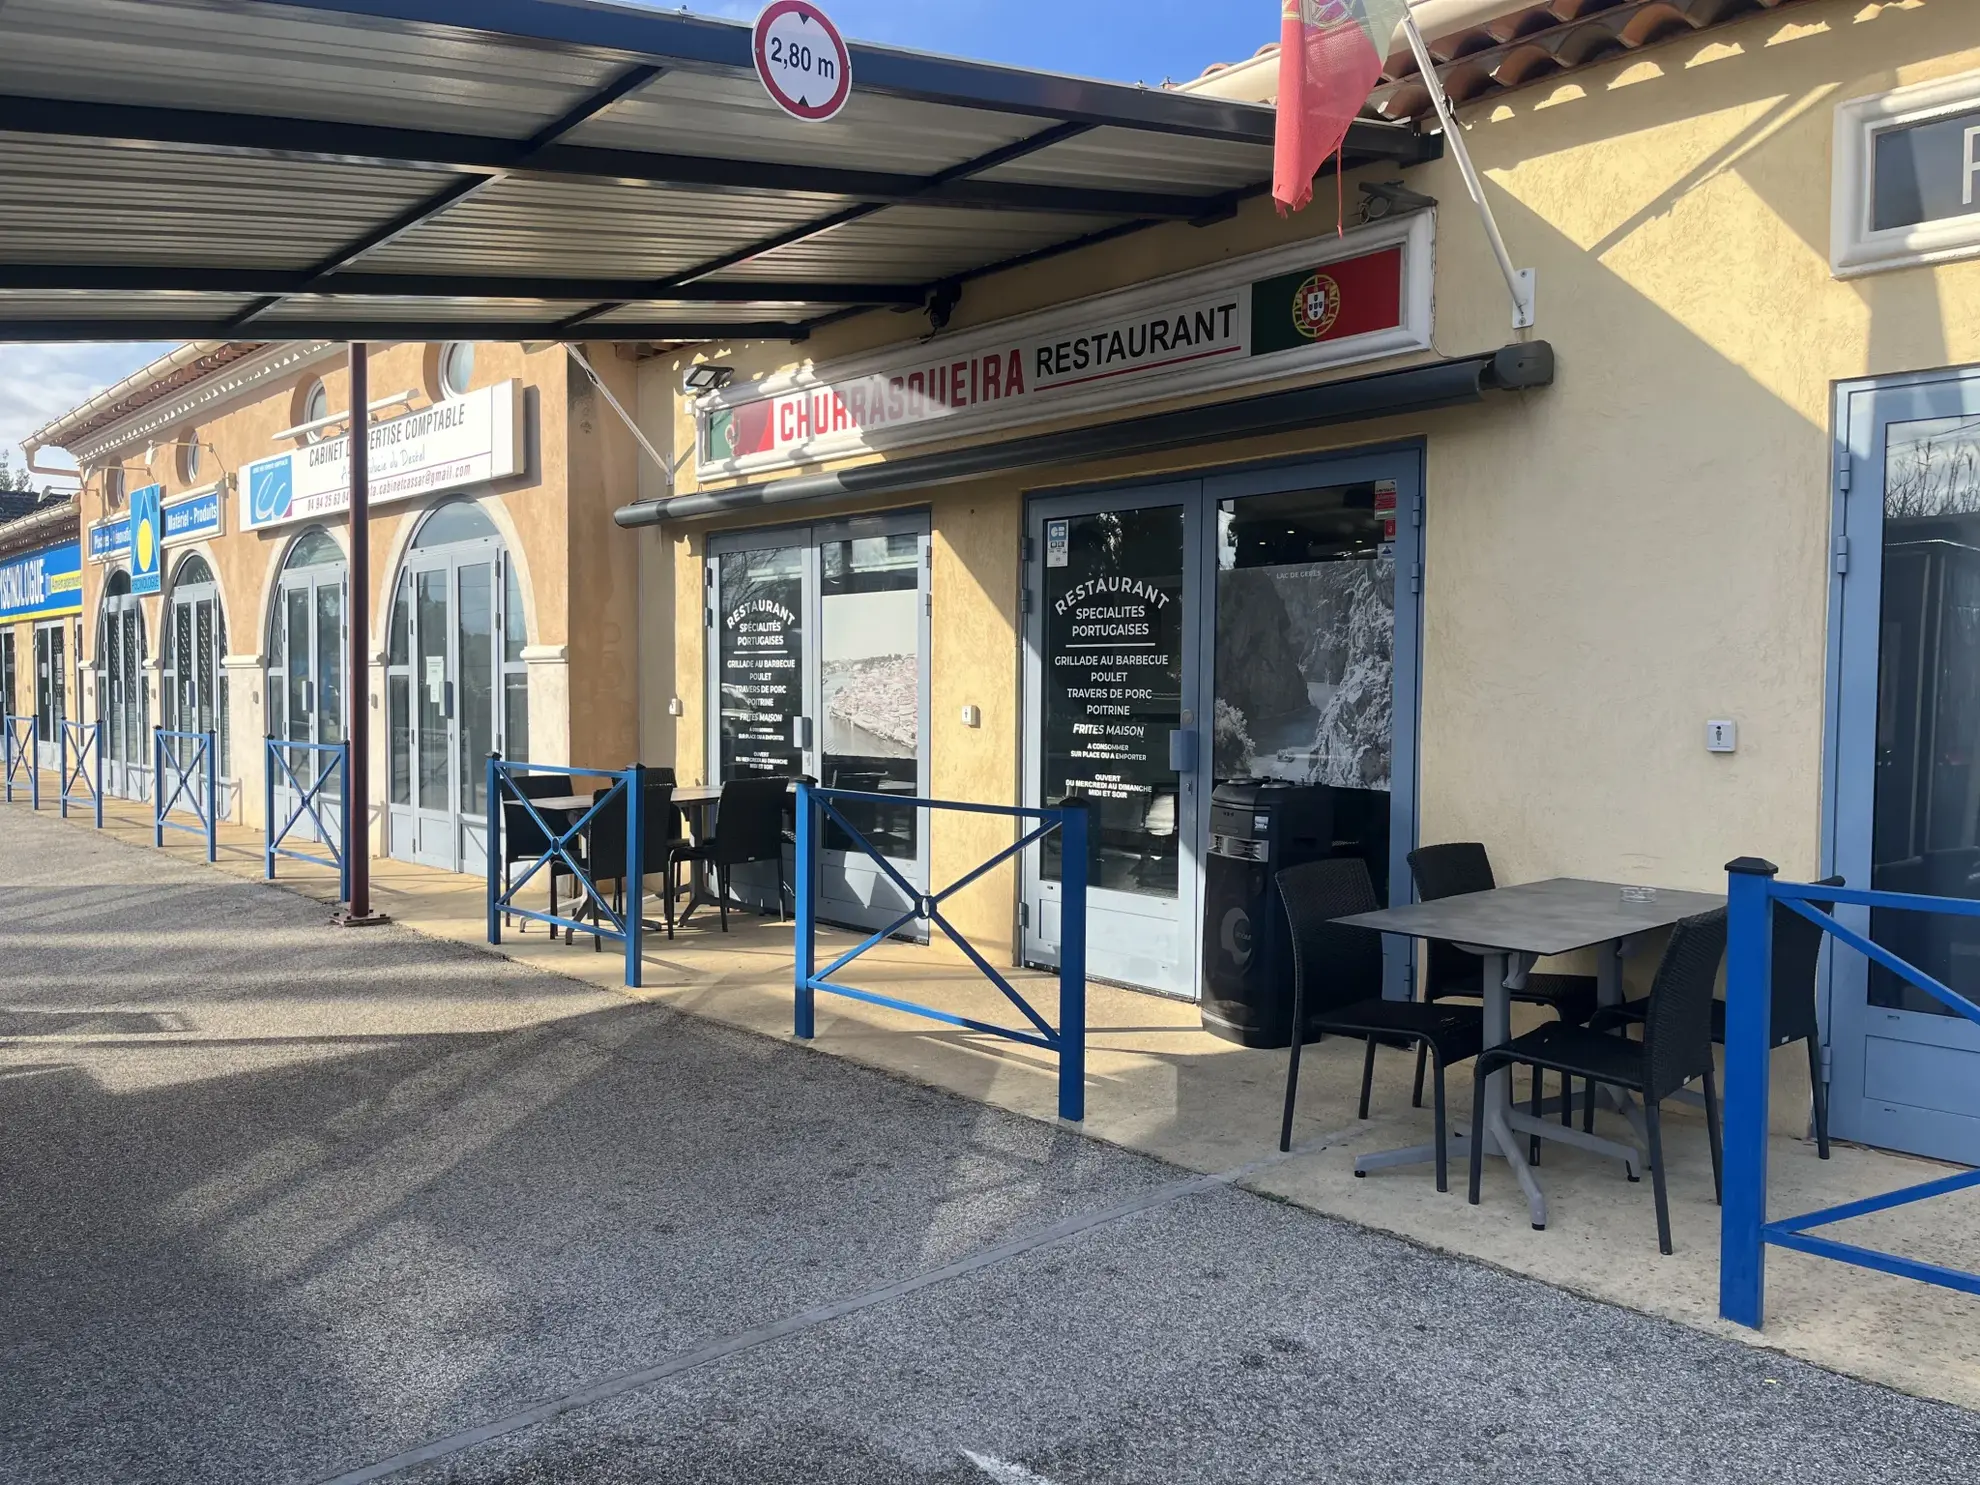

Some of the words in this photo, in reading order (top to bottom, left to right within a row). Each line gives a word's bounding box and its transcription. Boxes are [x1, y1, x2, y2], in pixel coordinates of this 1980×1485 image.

[771, 37, 811, 72] 2,80
[817, 57, 834, 80] m
[780, 348, 1025, 443] CHURRASQUEIRA
[1036, 302, 1237, 378] RESTAURANT
[309, 440, 344, 468] CABINET
[405, 403, 466, 441] COMPTABLE
[193, 502, 218, 524] Produits
[1054, 576, 1170, 616] RESTAURANT
[726, 599, 796, 630] RESTAURANT
[1076, 605, 1146, 620] SPECIALITES
[1072, 623, 1149, 637] PORTUGAISES
[737, 635, 784, 646] PORTUGAISES
[727, 659, 754, 669] GRILLADE
[755, 659, 764, 668] AU
[764, 659, 796, 668] BARBECUE
[1054, 655, 1099, 666] GRILLADE
[1100, 655, 1113, 666] AU
[1116, 654, 1169, 665] BARBECUE
[750, 672, 772, 681] POULET
[1090, 672, 1128, 682] POULET
[735, 685, 760, 694] TRAVERS
[761, 685, 770, 693] DE
[770, 685, 787, 694] PORC
[1067, 688, 1107, 699] TRAVERS
[1110, 688, 1123, 699] DE
[1125, 689, 1152, 699] PORC
[748, 698, 774, 707] POITRINE
[1086, 704, 1130, 716] POITRINE
[740, 712, 759, 722] FRITES
[759, 713, 783, 722] MAISON
[1073, 723, 1104, 735] FRITES
[1106, 725, 1145, 736] MAISON
[1092, 743, 1129, 751] CONSOMMER
[1070, 750, 1082, 758] SUR
[1083, 750, 1100, 759] PLACE
[1115, 753, 1147, 761] EMPORTER
[1095, 774, 1121, 782] OUVERT
[1065, 779, 1074, 787] DU
[1075, 780, 1107, 789] MERCREDI
[1108, 782, 1118, 790] AU
[1118, 783, 1153, 793] DIMANCHE
[1088, 789, 1102, 797] MIDI
[1112, 790, 1128, 799] SOIR
